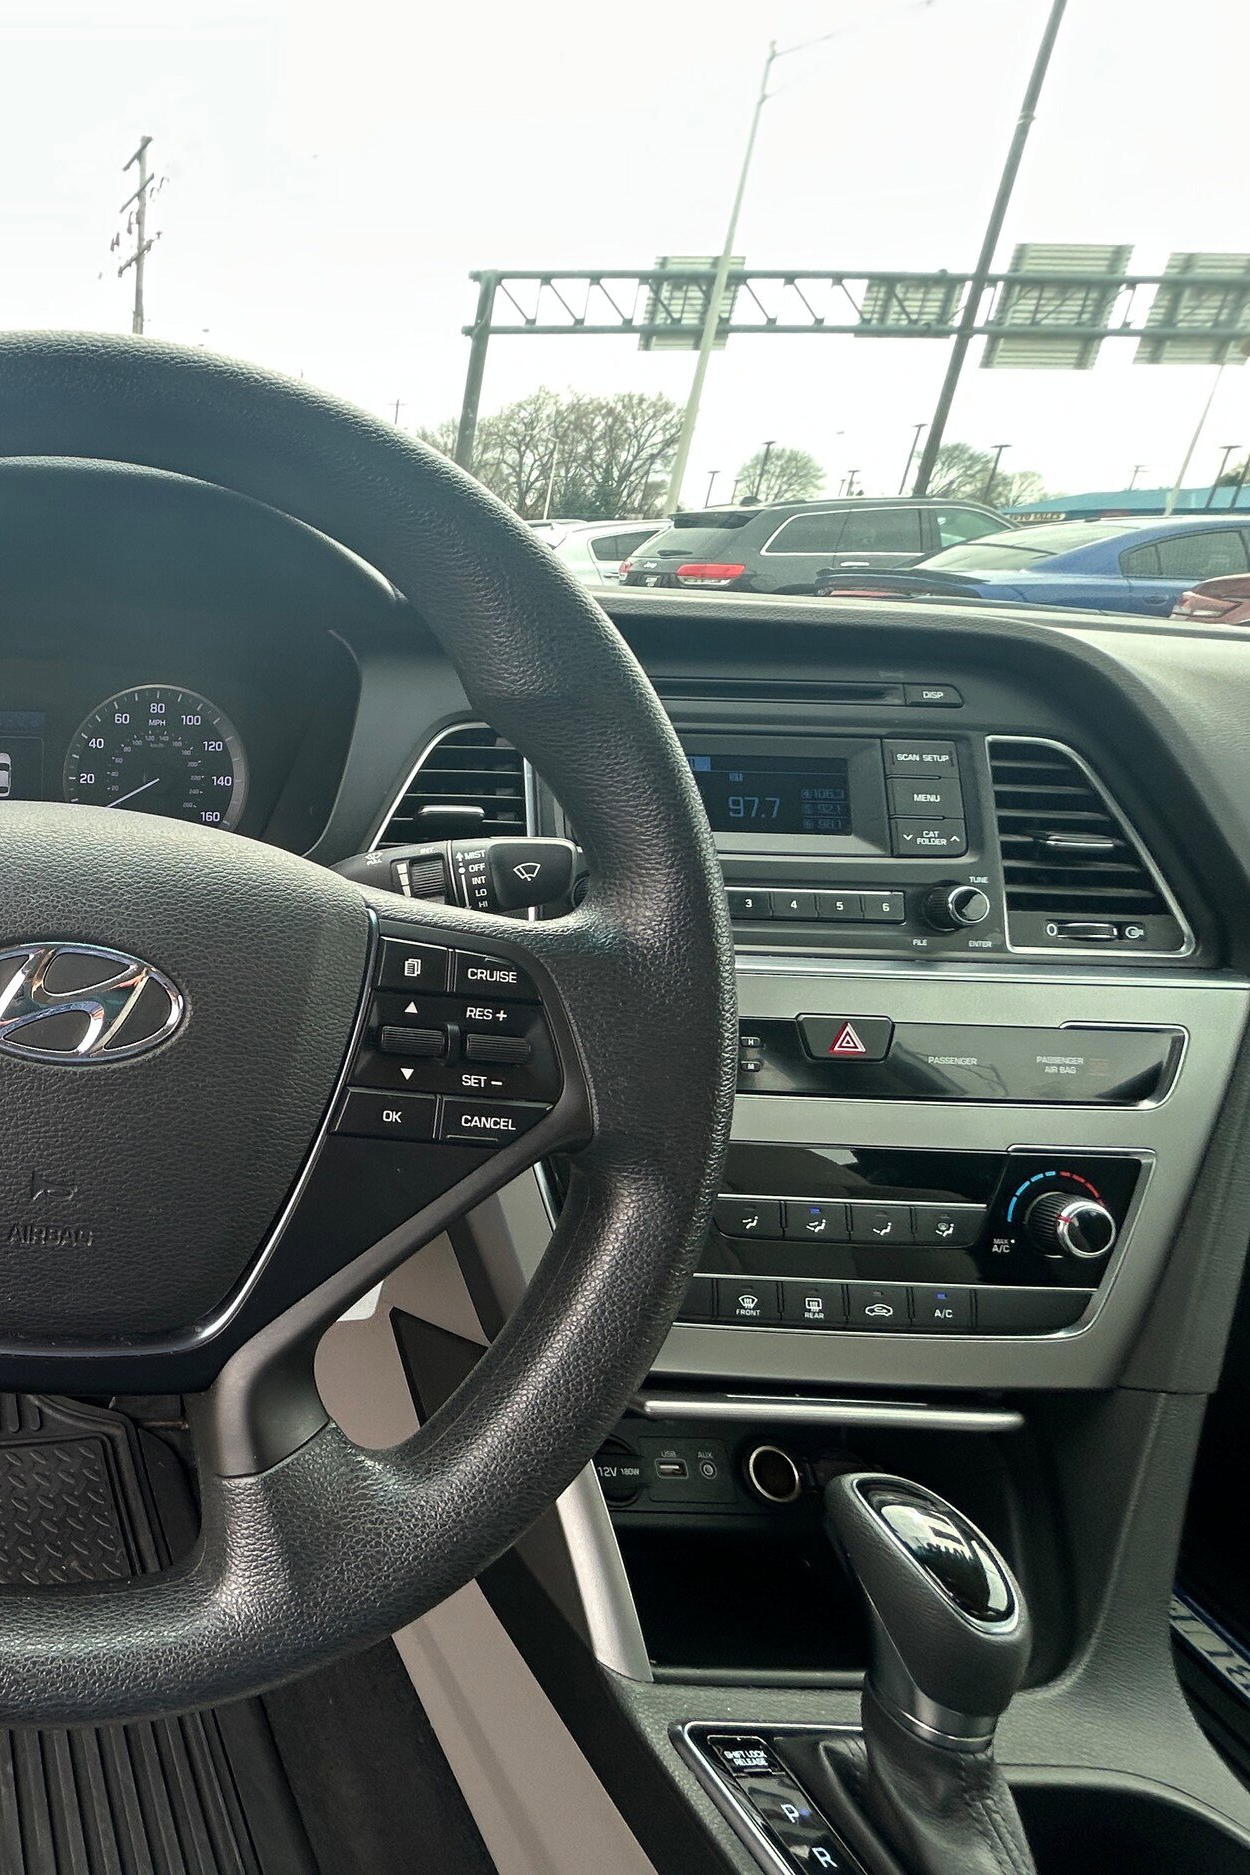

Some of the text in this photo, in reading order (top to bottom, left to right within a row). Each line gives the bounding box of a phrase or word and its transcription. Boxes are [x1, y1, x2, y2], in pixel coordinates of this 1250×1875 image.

[922, 691, 944, 699] DISP
[150, 703, 165, 713] 80
[114, 713, 130, 724] 60
[181, 715, 201, 725] 100
[88, 738, 104, 749] 40
[203, 741, 223, 751] 120
[896, 753, 949, 762] SCAN SETUP
[79, 773, 95, 784] 20
[212, 776, 232, 786] 140
[913, 793, 941, 802] MENU
[728, 796, 781, 818] 97.7
[200, 811, 220, 822] 160
[922, 830, 940, 838] CAT
[916, 837, 947, 846] FOLDER
[464, 849, 486, 860] MIST
[469, 863, 486, 873] OFF
[472, 876, 486, 885] INT
[969, 876, 989, 884] TUNE
[475, 888, 488, 897] LO
[478, 900, 489, 908] HI
[745, 898, 752, 908] 3
[790, 900, 797, 909] 4
[836, 901, 844, 911] 5
[882, 902, 890, 912] 6
[912, 938, 928, 946] FILE
[968, 940, 992, 948] ENTER
[467, 968, 517, 983] CRUISE
[928, 1056, 978, 1065] PASSENGER
[1036, 1056, 1084, 1065] PASSENGER
[1044, 1066, 1059, 1074] AIR
[382, 1110, 402, 1123] OK
[461, 1115, 516, 1131] CANCEL
[992, 1244, 1010, 1253] A/C
[736, 1308, 761, 1317] FRONT
[804, 1311, 825, 1320] REAR
[933, 1308, 954, 1319] A/C
[597, 1466, 617, 1477] 12V
[780, 1803, 800, 1824] P
[812, 1847, 839, 1868] R
